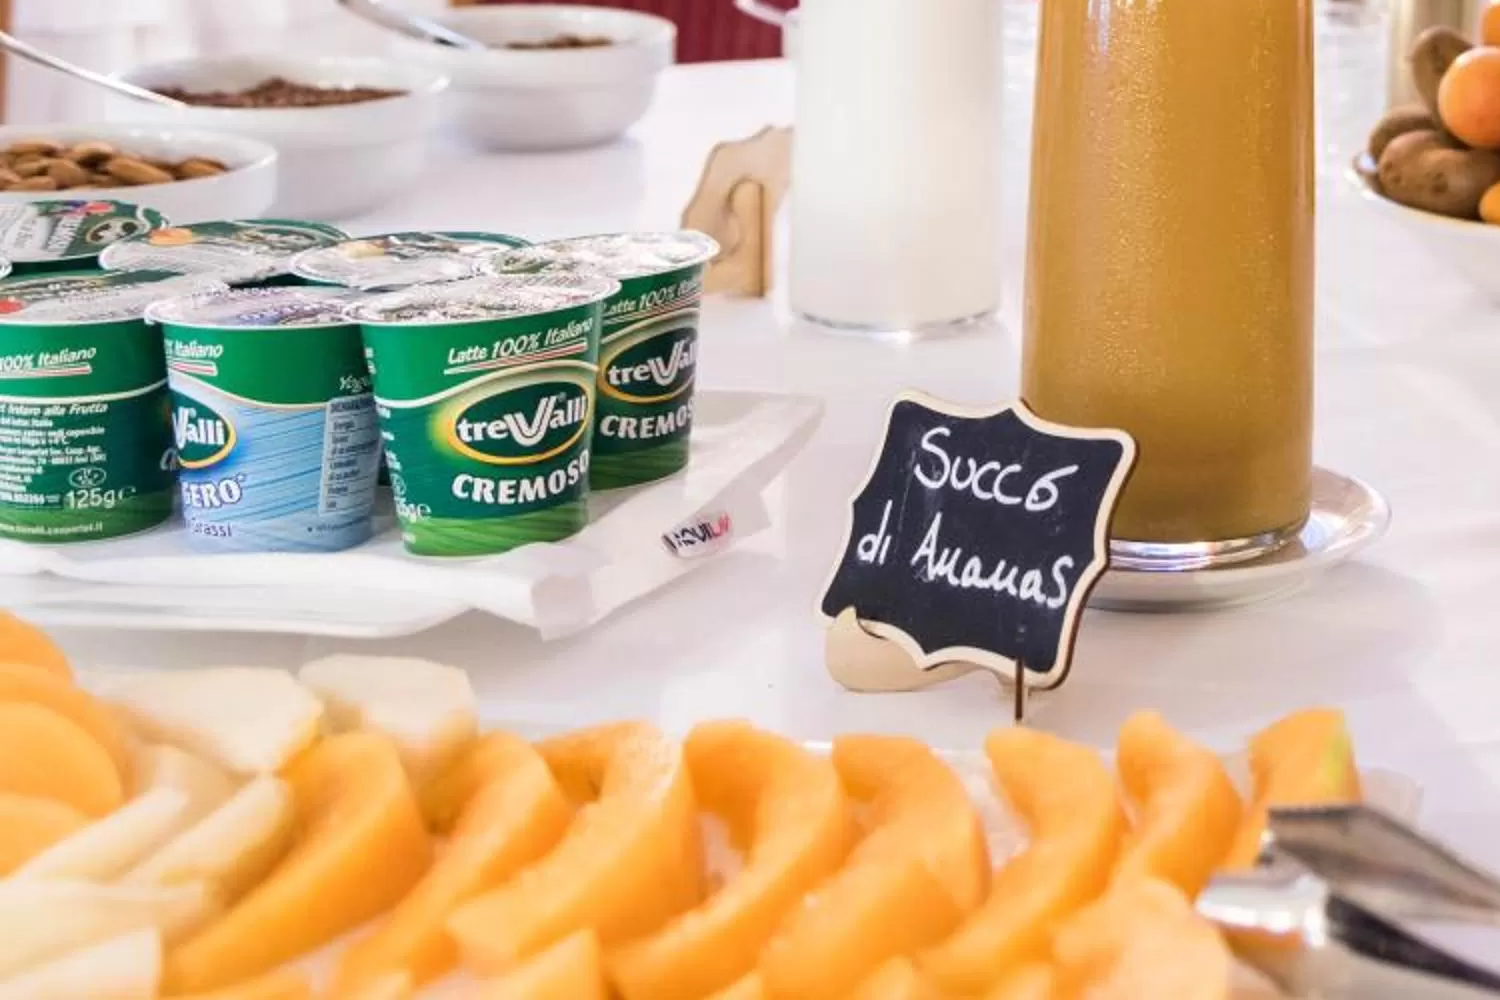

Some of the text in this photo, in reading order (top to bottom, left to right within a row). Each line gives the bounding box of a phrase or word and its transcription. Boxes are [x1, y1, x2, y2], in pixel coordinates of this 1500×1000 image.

[38, 347, 97, 368] Italiano
[447, 346, 488, 365] Latte
[491, 331, 541, 359] 100%
[172, 405, 225, 450] Valli
[600, 397, 695, 440] CREMOS
[65, 487, 116, 510] 125g
[451, 449, 590, 505] CREMOSO
[857, 499, 1074, 608] di Ananas
